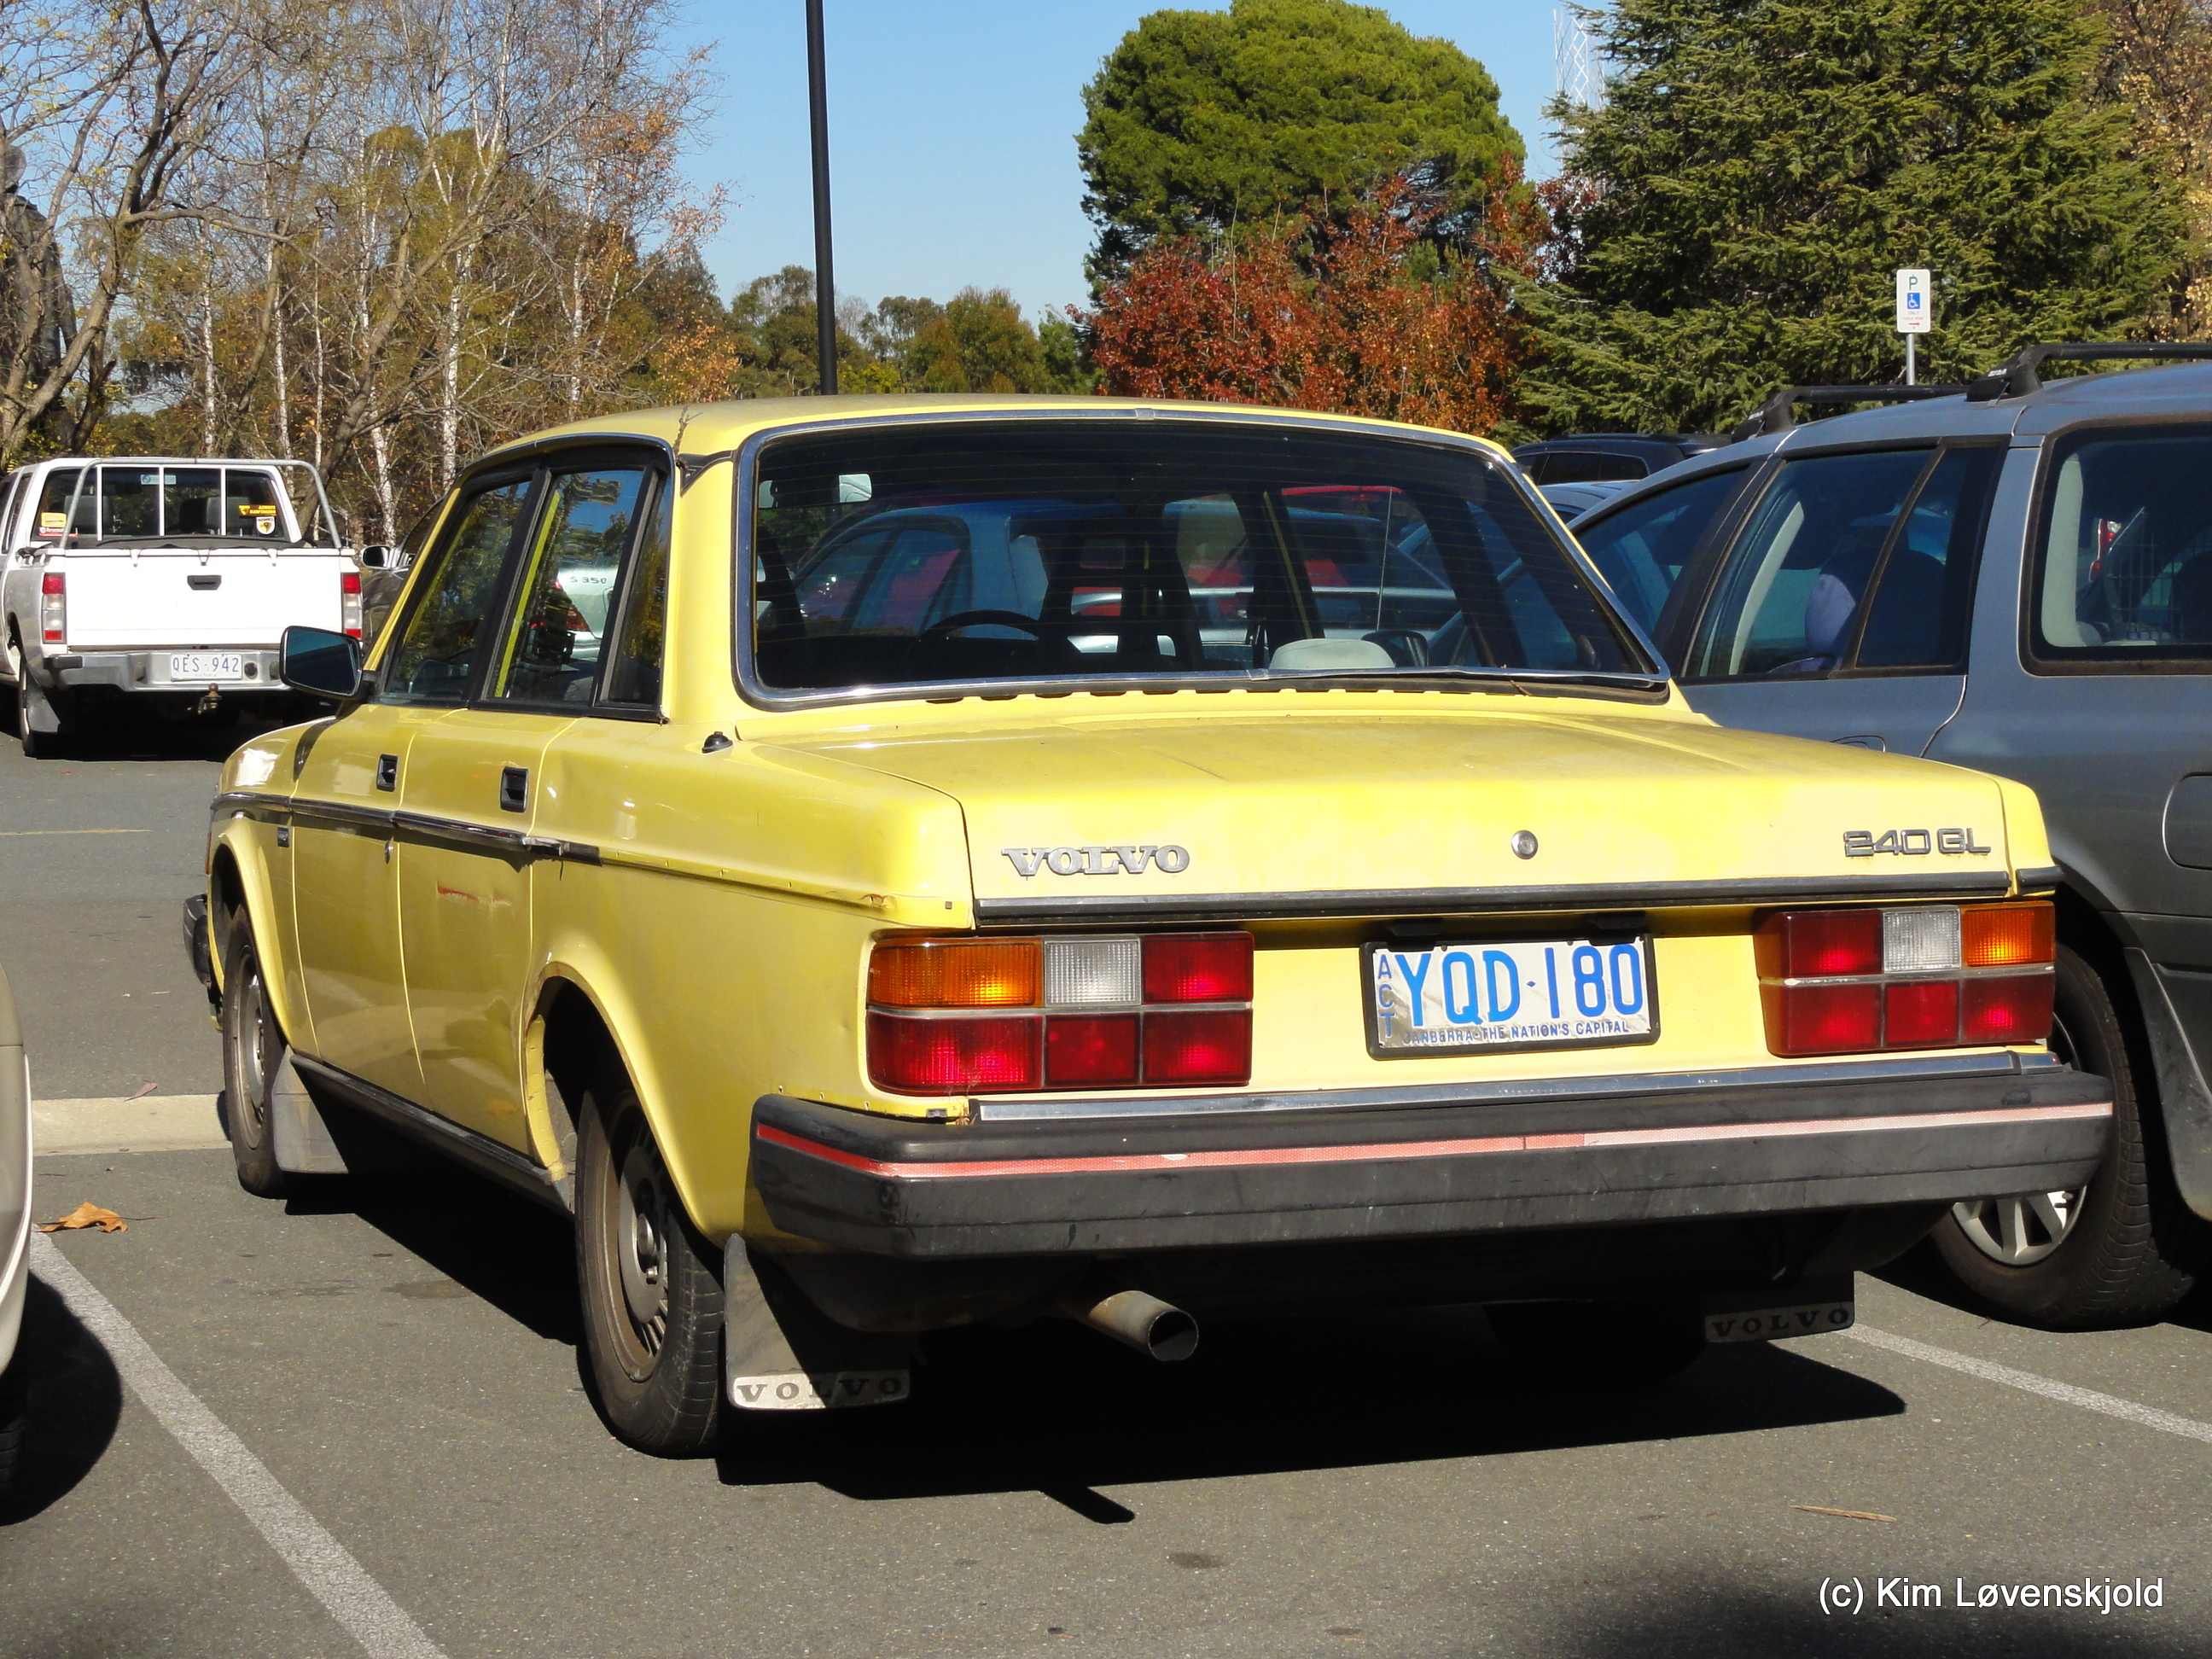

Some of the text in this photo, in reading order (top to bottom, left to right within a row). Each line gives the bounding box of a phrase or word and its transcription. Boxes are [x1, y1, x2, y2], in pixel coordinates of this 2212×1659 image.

[1908, 276, 1918, 291] P
[582, 576, 607, 585] 350
[1842, 828, 1992, 858] 240 GL
[1000, 844, 1190, 877] VOLVO
[1511, 1023, 1570, 1039] NATION'S
[1575, 1020, 1630, 1035] CAPITAL
[1711, 1307, 1850, 1337] VOLVO
[736, 1377, 903, 1403] VOLVO
